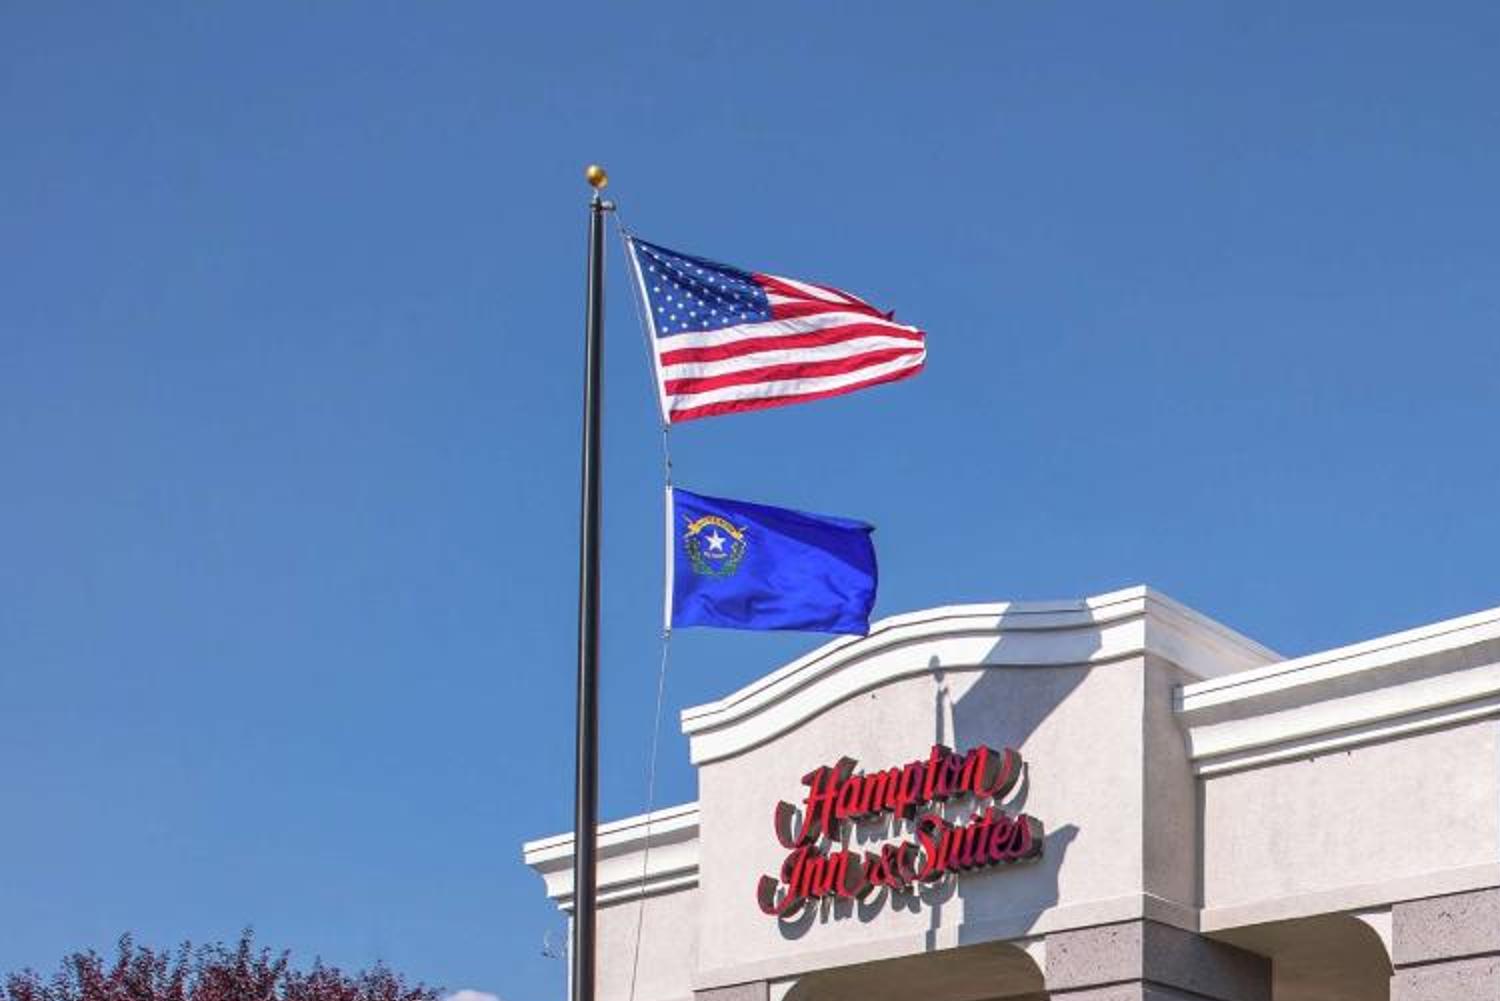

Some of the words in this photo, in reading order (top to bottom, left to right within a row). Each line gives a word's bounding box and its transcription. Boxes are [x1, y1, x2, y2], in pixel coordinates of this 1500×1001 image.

[774, 744, 1023, 849] Hampton
[757, 846, 869, 917] Inn
[898, 806, 1044, 883] Suites
